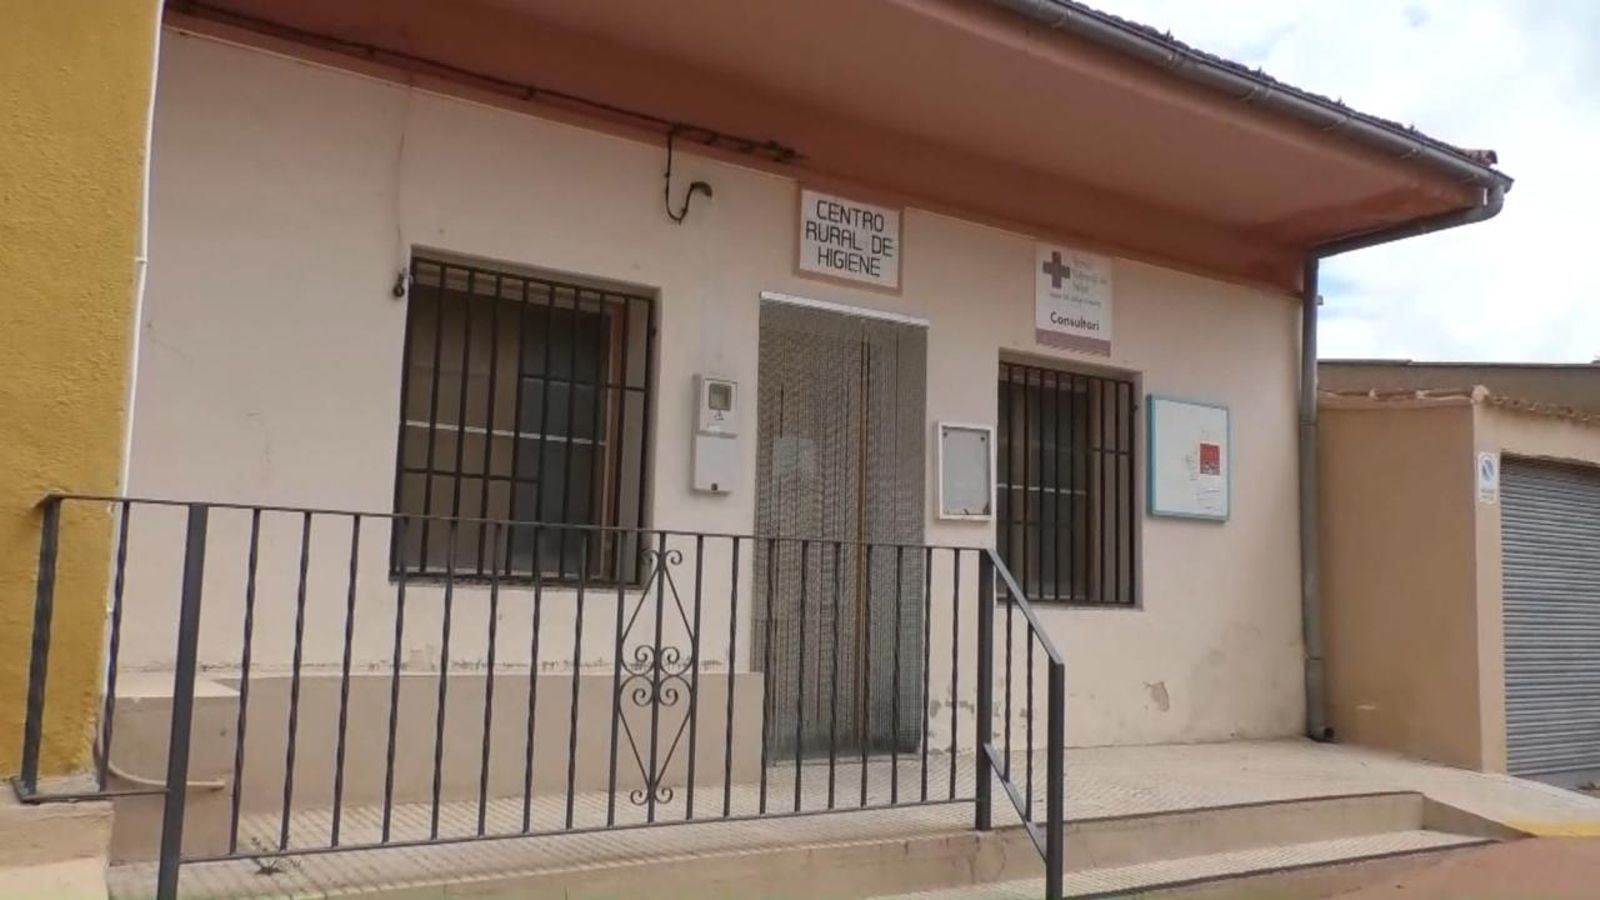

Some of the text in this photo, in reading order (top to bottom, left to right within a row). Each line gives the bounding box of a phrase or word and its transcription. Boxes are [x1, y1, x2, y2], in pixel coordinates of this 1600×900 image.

[816, 199, 885, 232] CENTRO
[805, 220, 894, 257] RURAL DE
[817, 246, 881, 277] HIGIENE
[1050, 311, 1100, 331] Consultori
